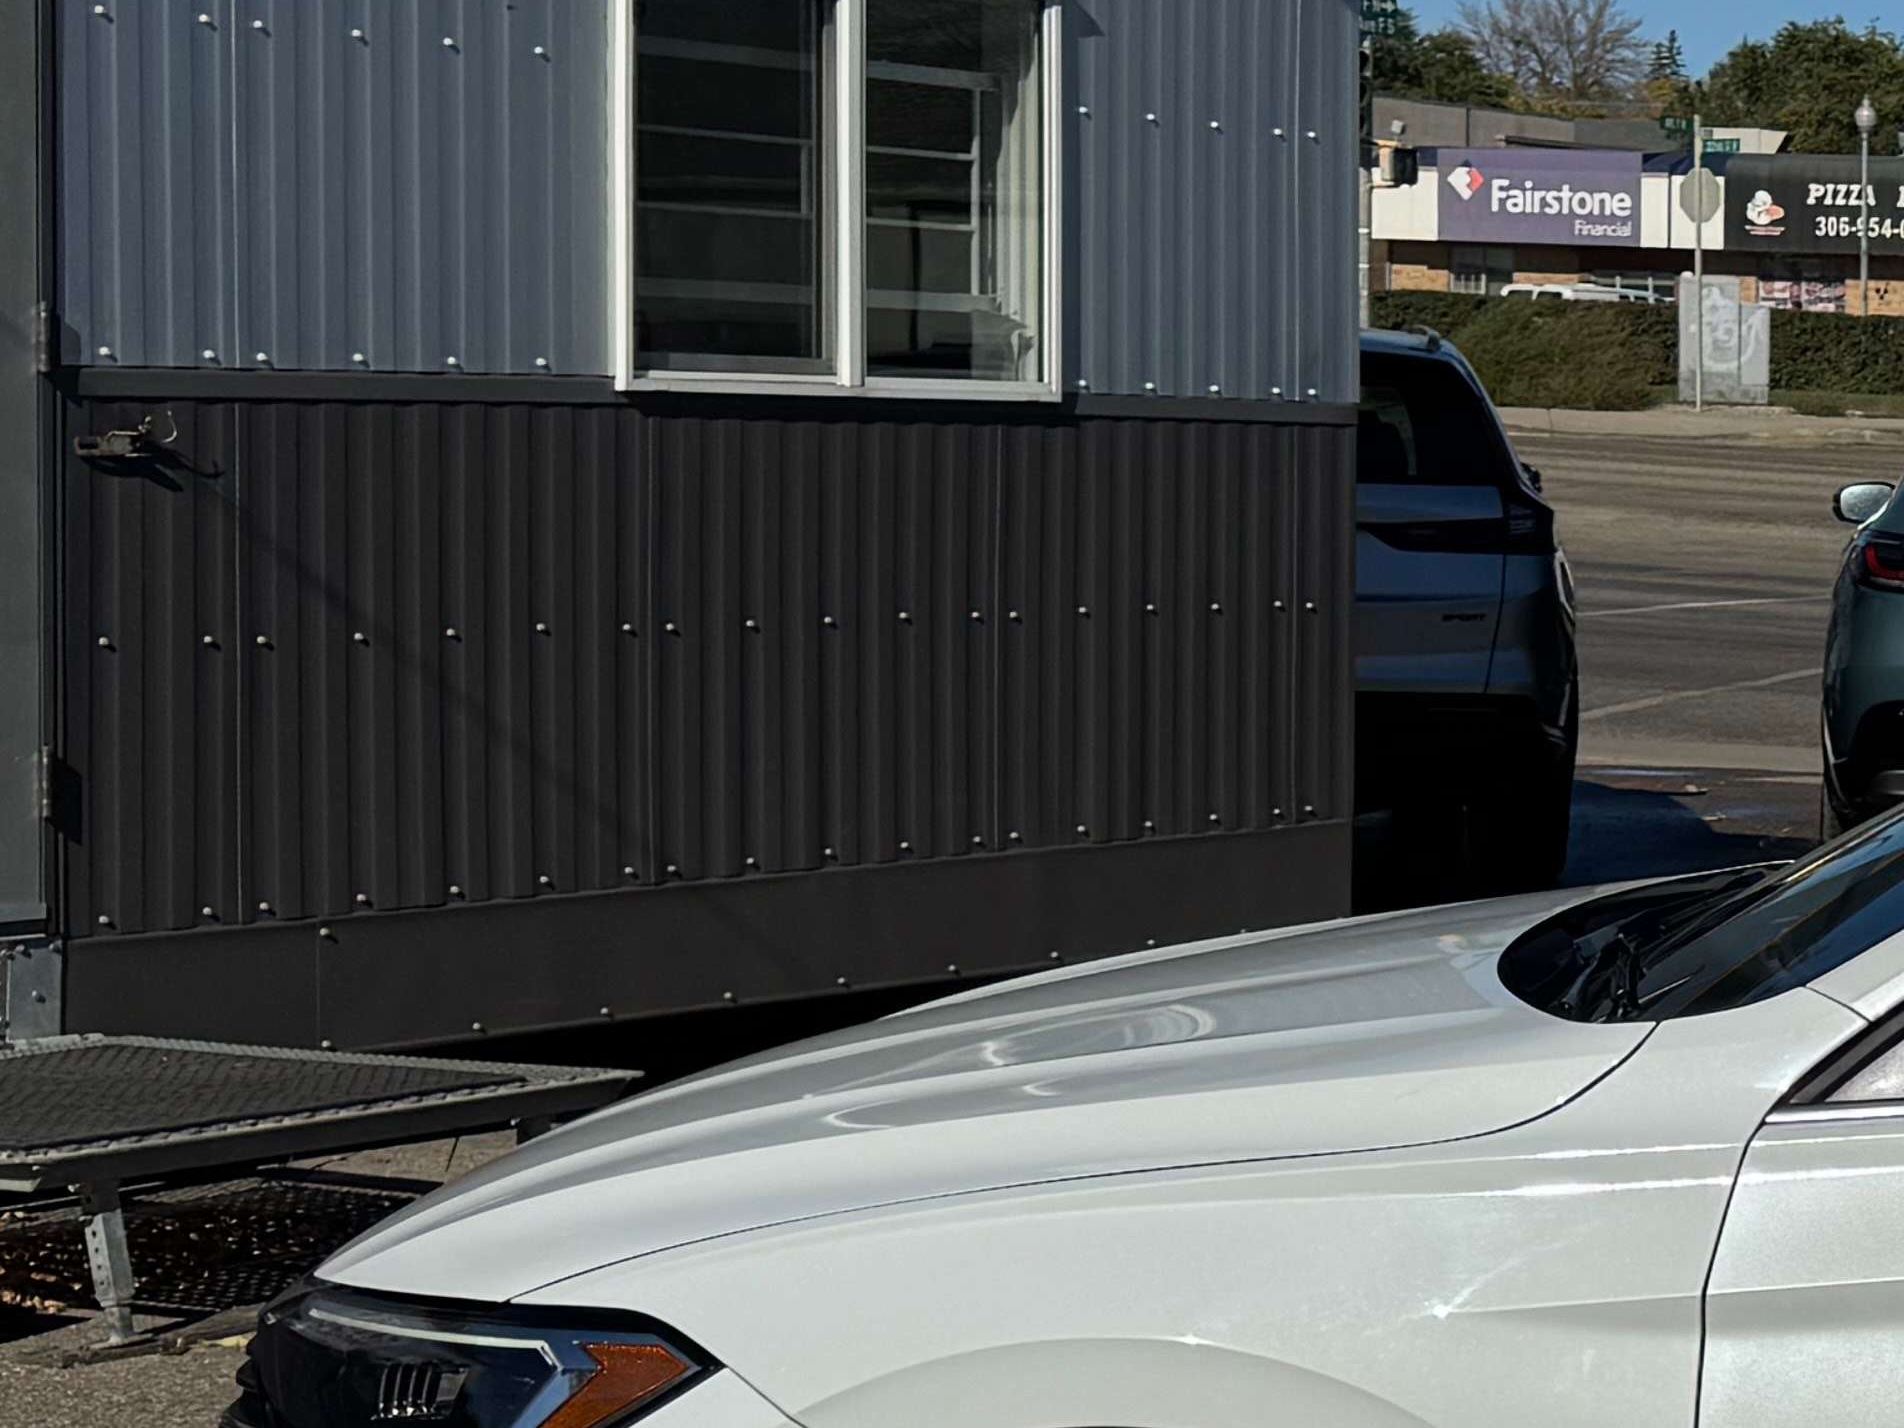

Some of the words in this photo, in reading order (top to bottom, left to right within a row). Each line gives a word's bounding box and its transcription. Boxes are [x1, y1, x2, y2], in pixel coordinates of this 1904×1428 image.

[1491, 179, 1632, 217] Fairstone
[1806, 183, 1876, 206] PIZZA
[1574, 220, 1631, 236] Financial
